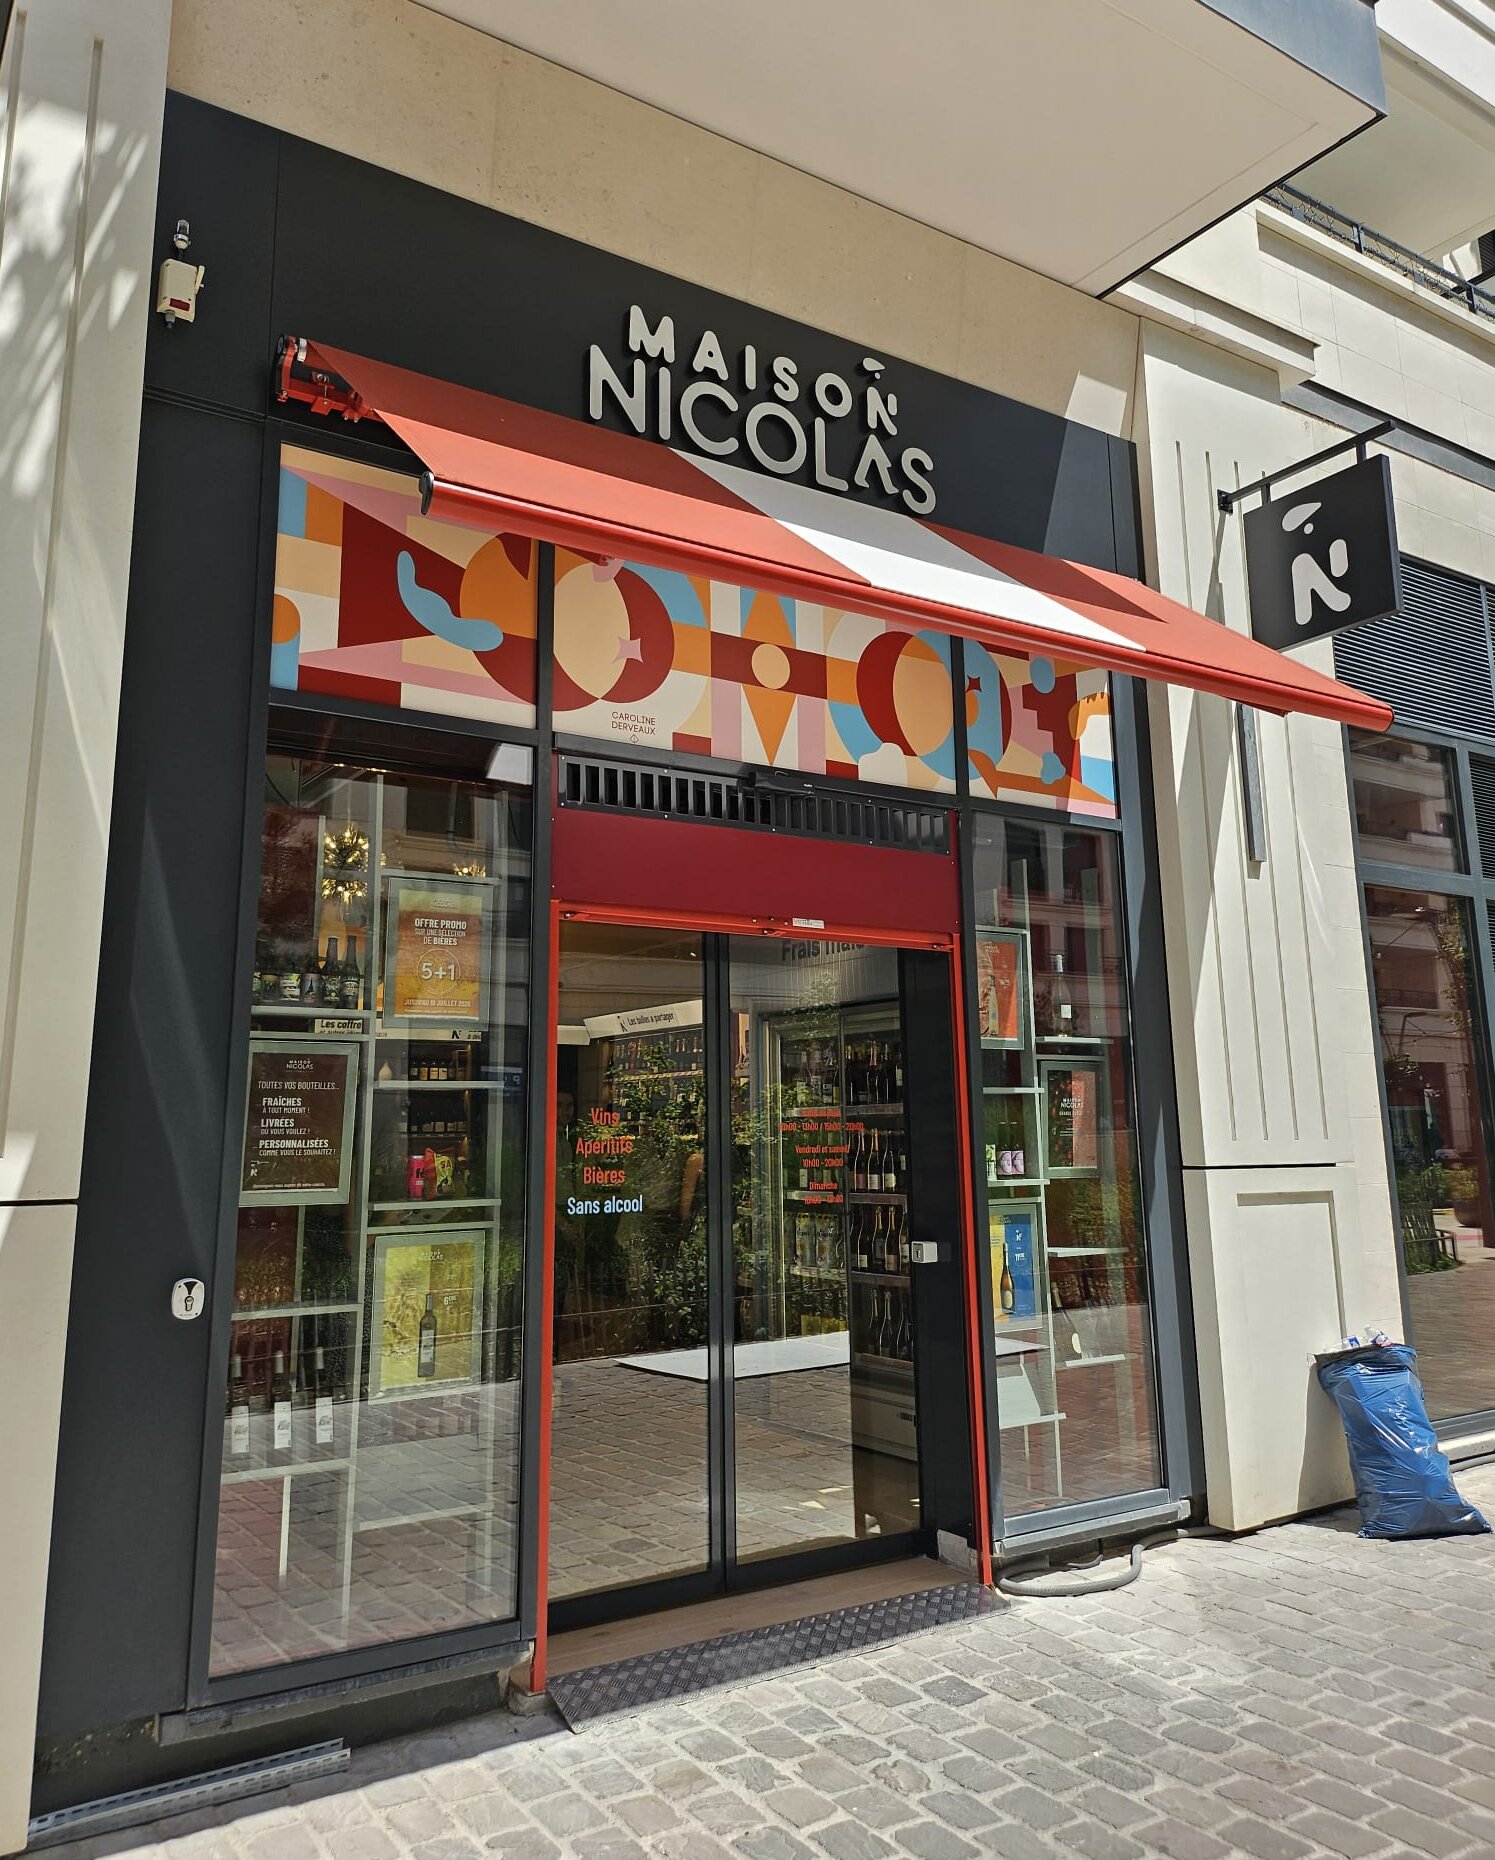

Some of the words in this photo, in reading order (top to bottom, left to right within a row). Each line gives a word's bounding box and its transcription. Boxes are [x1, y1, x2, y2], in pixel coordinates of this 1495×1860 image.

[629, 305, 898, 436] MAISON
[590, 344, 936, 514] NICOLAS
[611, 711, 656, 726] CAROLINE
[611, 720, 656, 735] DERVEAUX
[414, 918, 440, 928] OFFRE
[440, 919, 467, 930] PROMO
[423, 936, 432, 945] DE
[421, 961, 456, 981] 5+1
[320, 1019, 335, 1029] Les
[258, 1081, 283, 1090] TOUTES
[284, 1081, 297, 1090] VOS
[262, 1096, 302, 1107] FRAÎCHES
[261, 1116, 295, 1128] LIVRÉES
[590, 1107, 620, 1125] Vins
[286, 1127, 307, 1135] VOULEZ
[258, 1136, 329, 1149] PERSONNALISÉES
[259, 1149, 279, 1157] COMME
[794, 1145, 821, 1153] Vendredi
[583, 1166, 626, 1184] Bières
[809, 1181, 838, 1190] Dimanche
[567, 1196, 601, 1215] Sans
[603, 1194, 643, 1214] alcool
